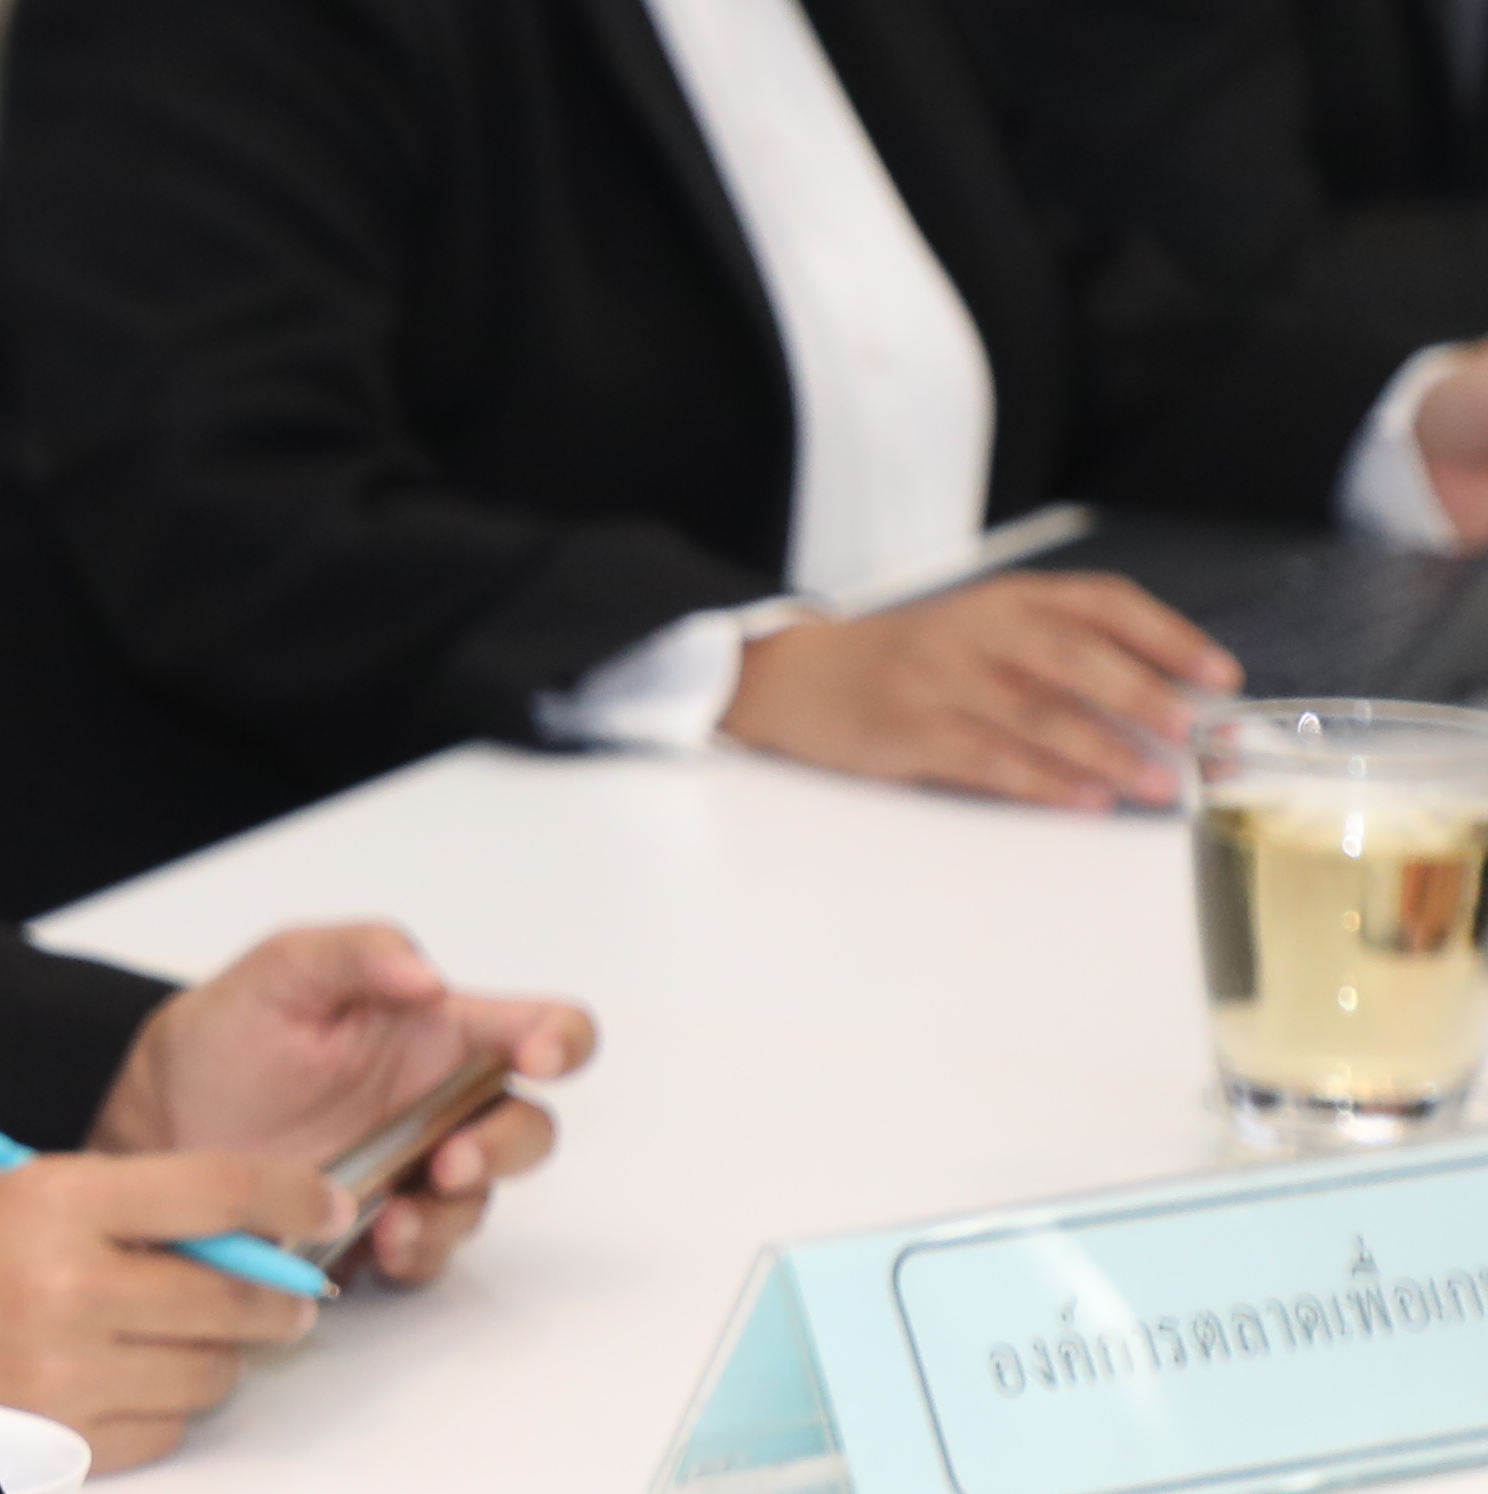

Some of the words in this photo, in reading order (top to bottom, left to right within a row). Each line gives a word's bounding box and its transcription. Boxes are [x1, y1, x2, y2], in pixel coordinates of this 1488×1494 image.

[988, 1232, 1488, 1399] องค์การตลาดเพื่อเก
